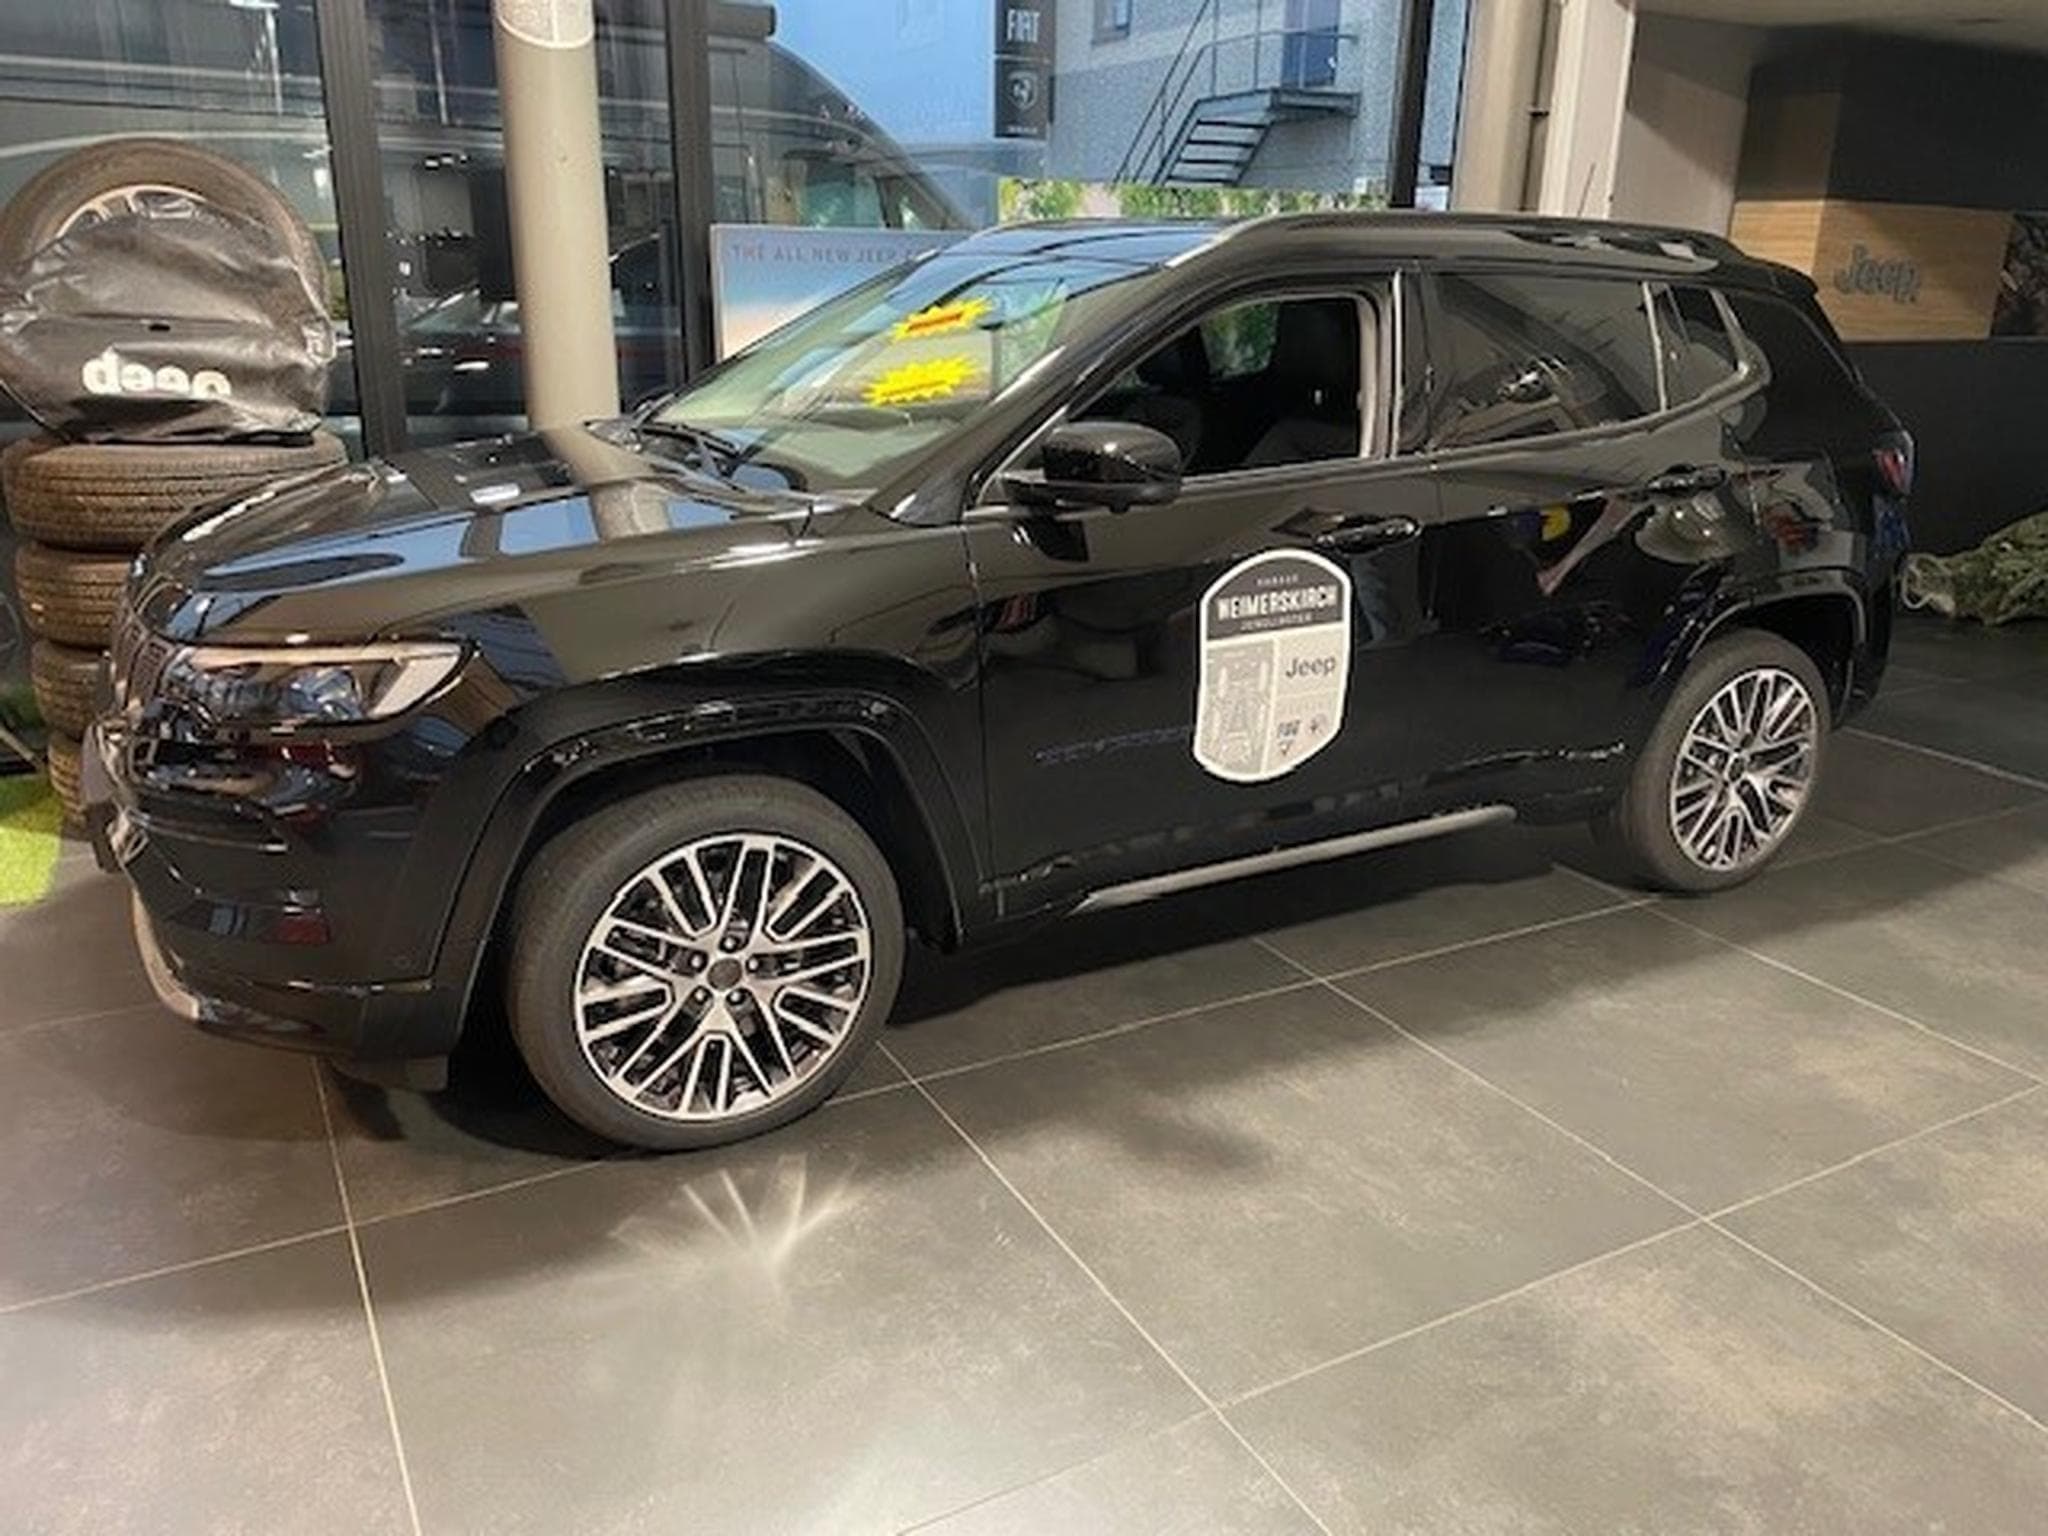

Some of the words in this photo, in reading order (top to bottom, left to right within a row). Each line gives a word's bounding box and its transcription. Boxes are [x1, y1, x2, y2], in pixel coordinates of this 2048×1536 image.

[1006, 8, 1041, 43] FIAT
[732, 242, 765, 261] THE
[773, 245, 805, 262] ALL
[811, 246, 850, 263] NEW
[1285, 656, 1336, 679] Jeep
